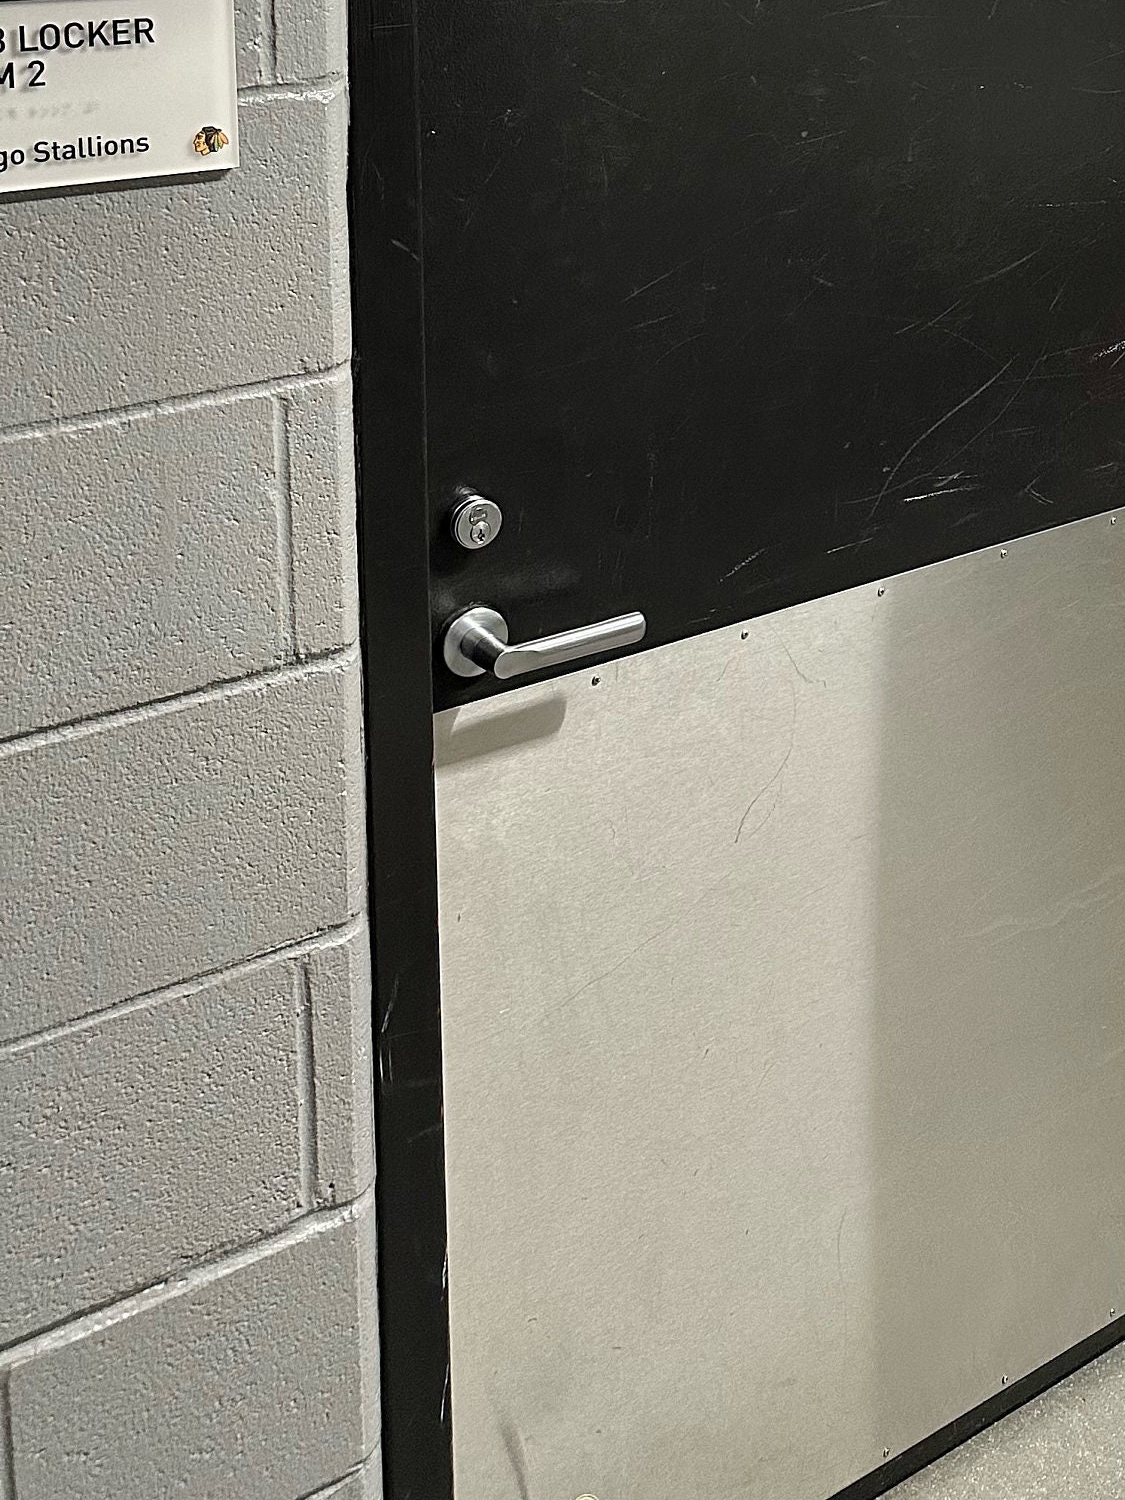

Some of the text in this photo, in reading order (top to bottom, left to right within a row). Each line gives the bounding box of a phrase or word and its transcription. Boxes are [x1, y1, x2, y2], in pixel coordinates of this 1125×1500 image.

[18, 17, 155, 52] LOCKER
[28, 60, 46, 87] 2
[33, 135, 150, 163] Stallions
